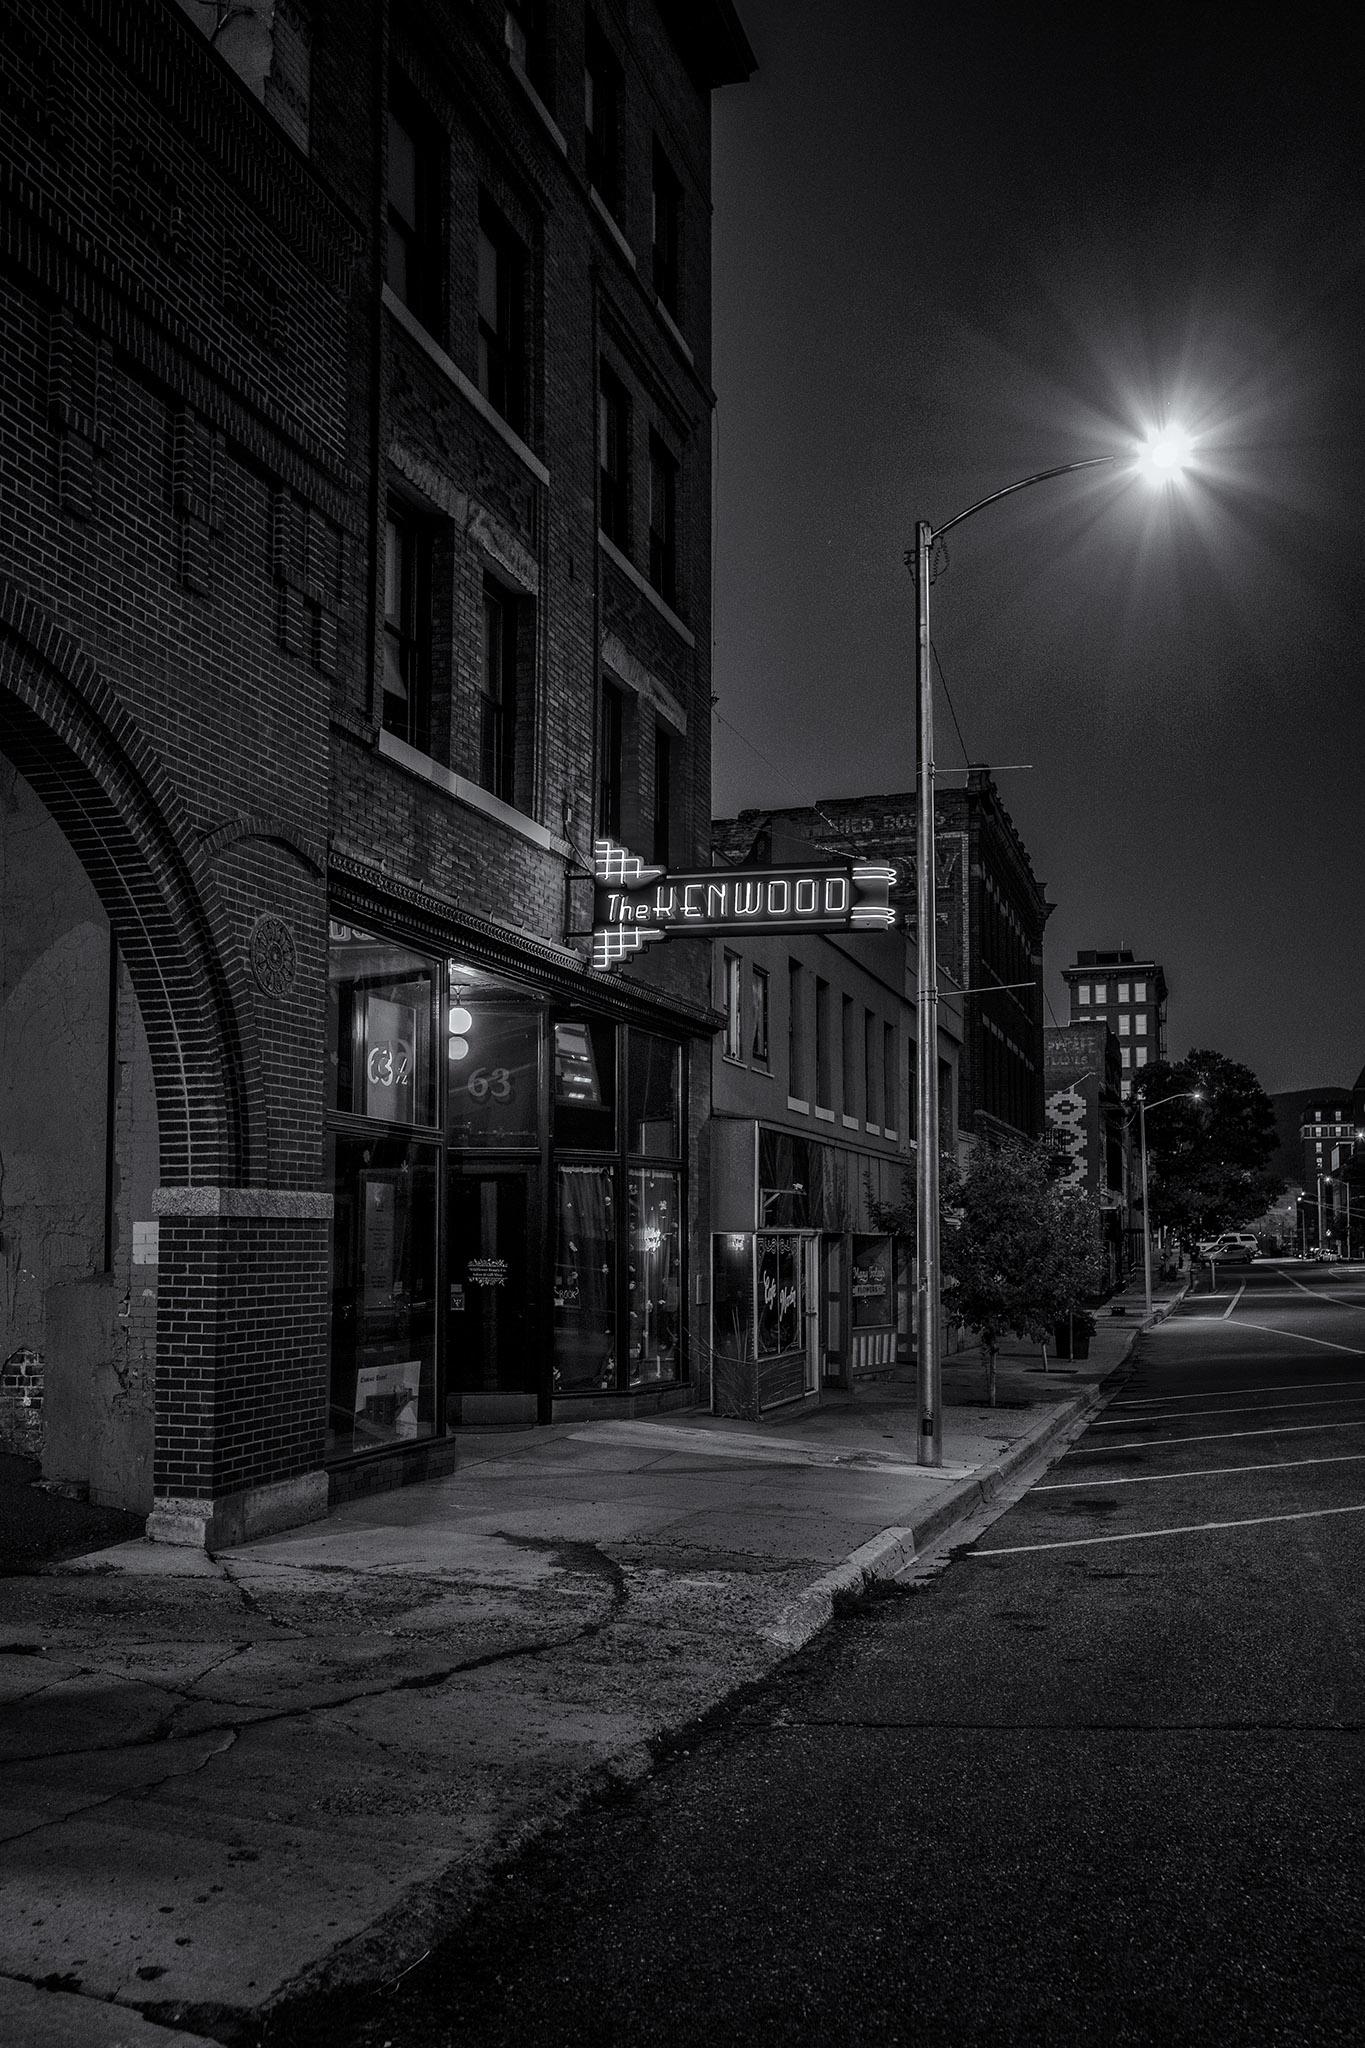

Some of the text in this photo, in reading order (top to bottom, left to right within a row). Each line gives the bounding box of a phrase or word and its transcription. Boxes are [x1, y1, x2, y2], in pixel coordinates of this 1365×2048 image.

[607, 893, 649, 923] The
[653, 877, 849, 920] KENWOOD
[467, 1067, 513, 1100] 63
